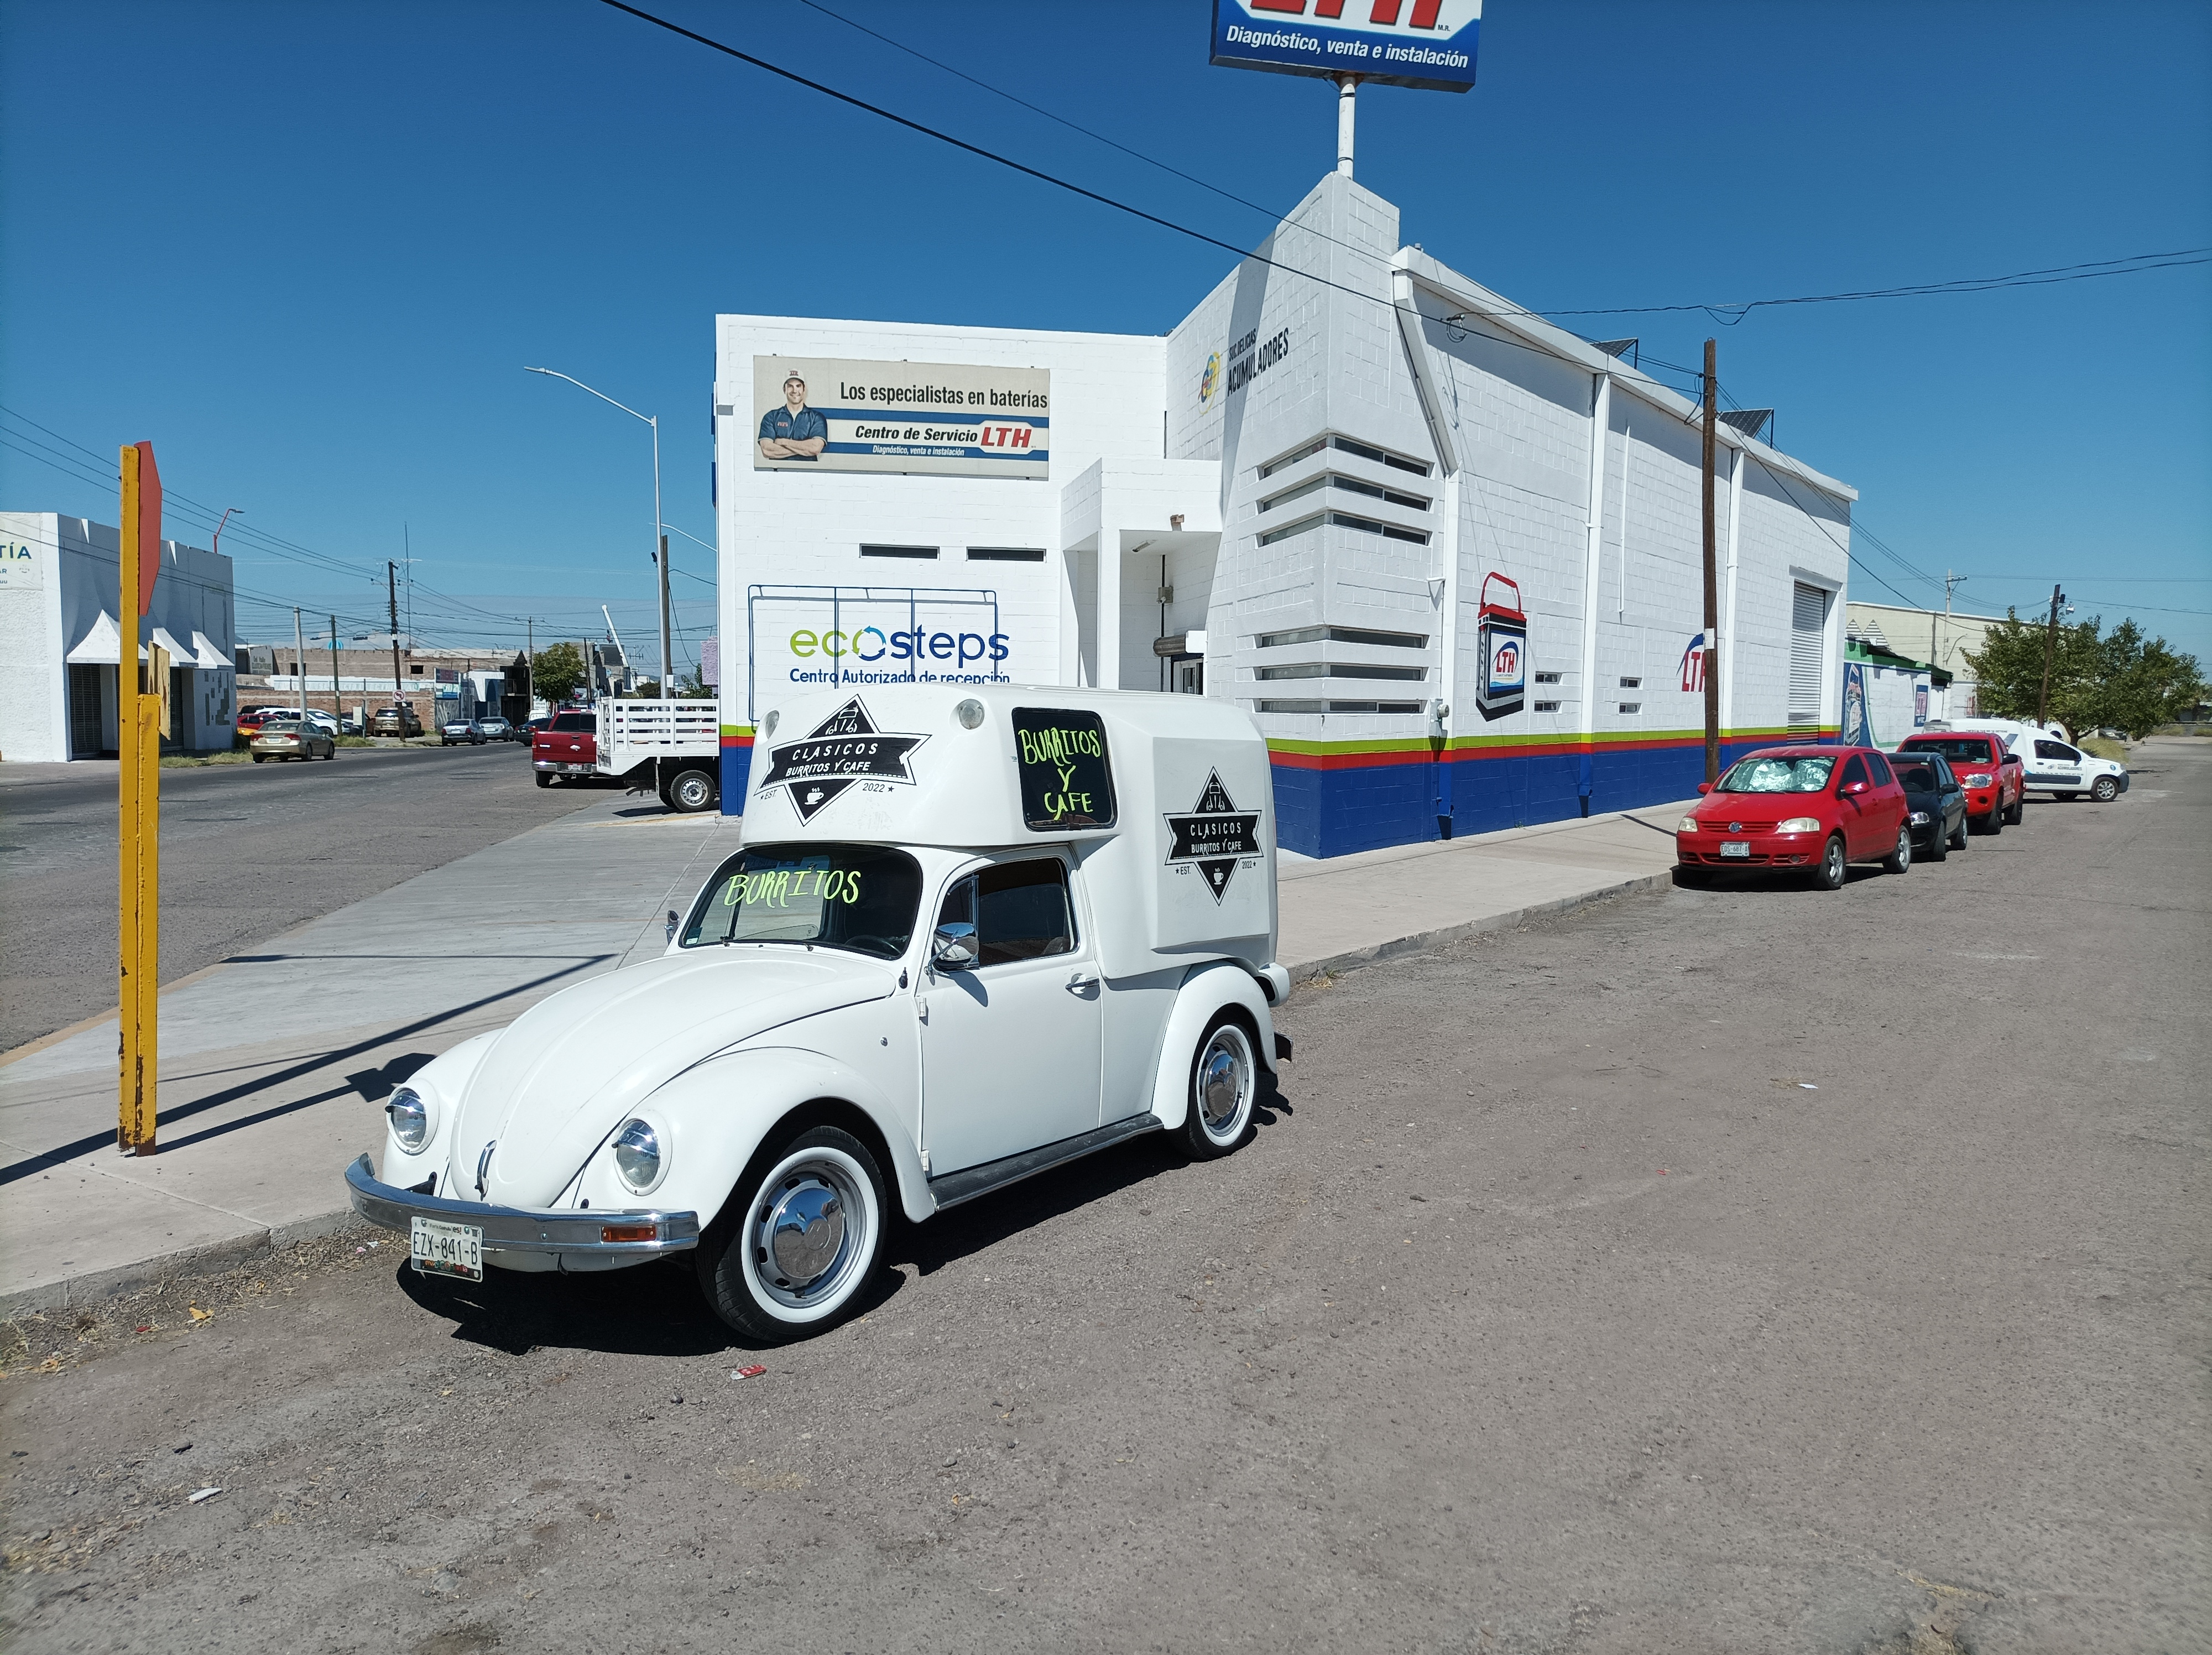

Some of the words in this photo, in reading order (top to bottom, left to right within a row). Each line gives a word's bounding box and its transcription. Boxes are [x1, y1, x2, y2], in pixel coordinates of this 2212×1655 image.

[1226, 25, 1322, 54] Diagnóstico,
[1327, 40, 1369, 58] venta
[1371, 46, 1382, 59] e
[1385, 44, 1469, 69] instalación
[1227, 327, 1289, 397] ACUMULADORES
[840, 382, 866, 400] Los
[870, 384, 964, 405] especialistas
[968, 390, 985, 405] en
[989, 388, 1048, 408] baterías
[855, 425, 900, 440] Centro
[904, 427, 920, 440] de
[924, 427, 978, 443] Servicio
[980, 426, 1032, 449] LTH
[872, 445, 909, 456] Diagnóstico,
[910, 447, 926, 455] venta
[932, 447, 964, 456] instalación
[790, 623, 1010, 669] ecosteps
[1495, 651, 1515, 673] LTH
[790, 668, 838, 683] Centro
[842, 669, 916, 684] Autorizado
[919, 670, 937, 683] de
[792, 742, 878, 762] CLASICOS
[1018, 727, 1101, 767] BURRITOS
[785, 762, 831, 777] BURRITOS
[833, 758, 846, 772] Y
[843, 761, 872, 774] CAFE
[1057, 765, 1076, 793] Y
[862, 783, 885, 793] 2022
[1044, 792, 1094, 821] CAFE
[1190, 822, 1241, 840] CLASICOS
[1191, 842, 1220, 856] BURRITOS
[1222, 838, 1228, 851] Y
[1227, 840, 1241, 855] CAFE
[1241, 860, 1253, 870] 2022
[723, 870, 862, 908] BURRITOS
[413, 1231, 478, 1266] EZX-841-B
